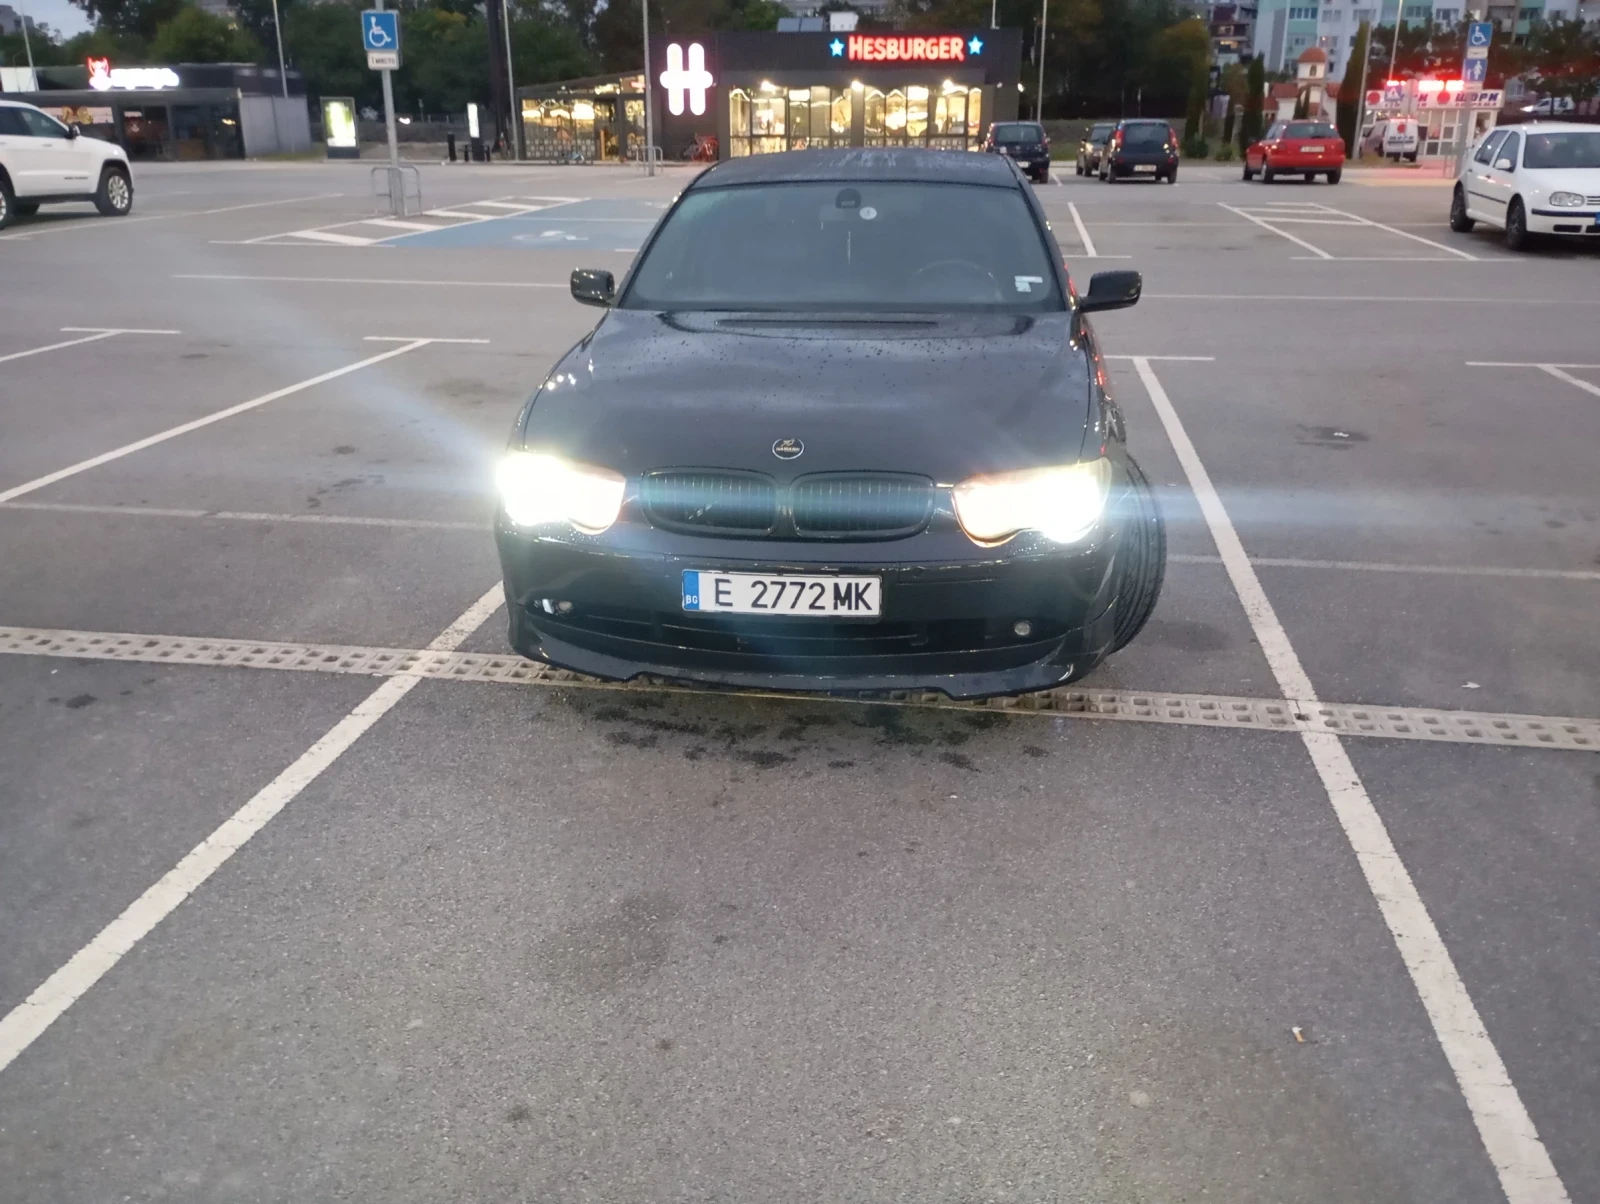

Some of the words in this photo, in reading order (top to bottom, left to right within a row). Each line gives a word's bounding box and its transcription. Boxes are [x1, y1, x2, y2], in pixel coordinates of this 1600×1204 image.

[848, 35, 964, 61] HESBURGER
[685, 594, 698, 604] BG
[714, 578, 733, 607] E
[750, 580, 826, 611] 2772
[832, 582, 872, 611] MK
